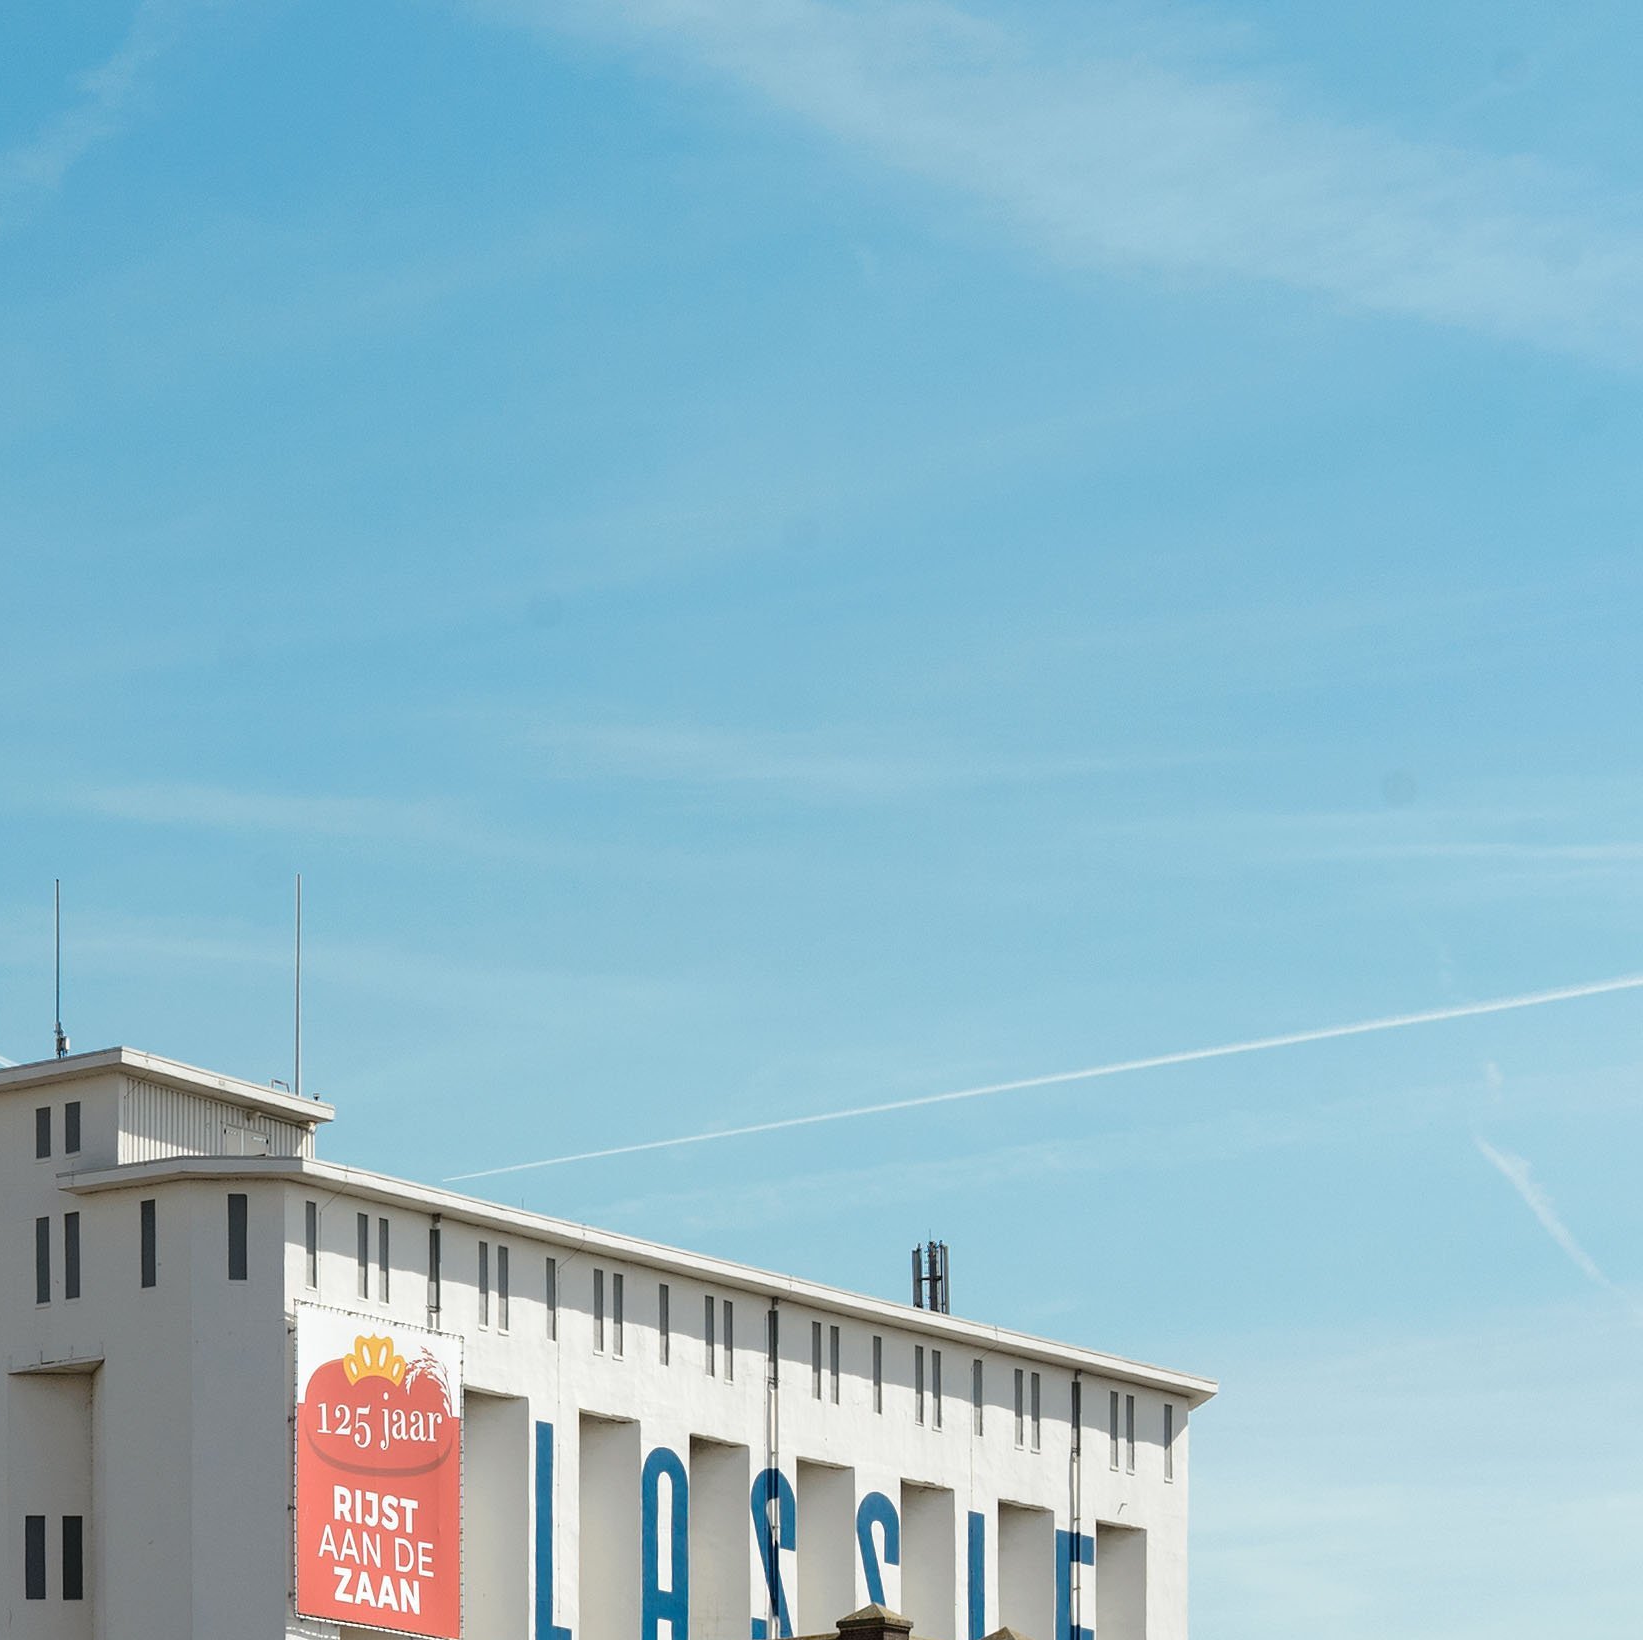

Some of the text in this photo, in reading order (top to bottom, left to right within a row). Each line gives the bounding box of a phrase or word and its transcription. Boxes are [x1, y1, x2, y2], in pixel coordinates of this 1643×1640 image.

[316, 1392, 442, 1450] 125 jaar
[333, 1485, 418, 1533] RIJST
[318, 1524, 434, 1577] AAN DE
[333, 1566, 421, 1615] ZAAN
